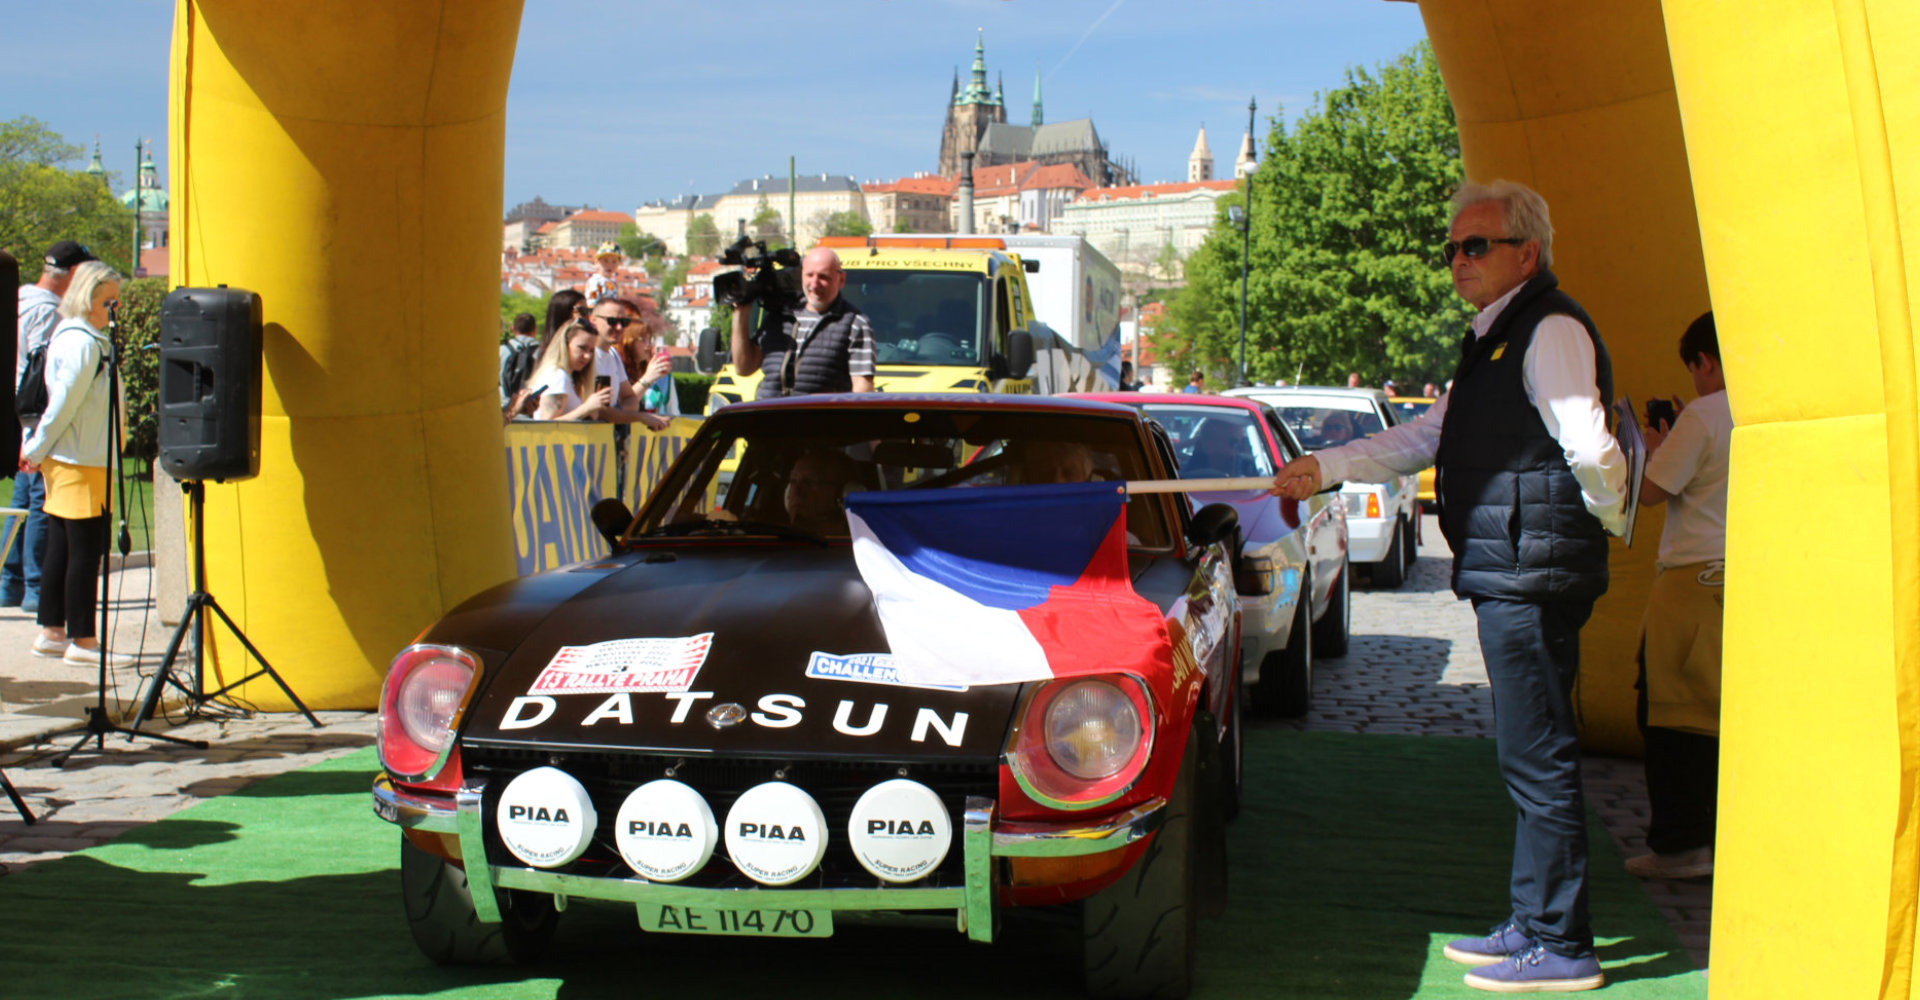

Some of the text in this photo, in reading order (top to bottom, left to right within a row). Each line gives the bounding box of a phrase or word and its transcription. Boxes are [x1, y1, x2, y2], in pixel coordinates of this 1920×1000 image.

[562, 672, 630, 688] RALLYE
[629, 668, 692, 687] PRAHA
[498, 691, 970, 748] DATSUN
[509, 804, 570, 824] PIAA
[628, 820, 693, 838] PIAA
[739, 822, 806, 841] PIAA
[867, 819, 935, 835] PIAA
[540, 847, 565, 858] RACING
[637, 860, 687, 874] SUPER RACING
[747, 862, 798, 877] SUPER RACING
[875, 859, 928, 873] SUPER RACING
[658, 904, 814, 934] AE 11470
